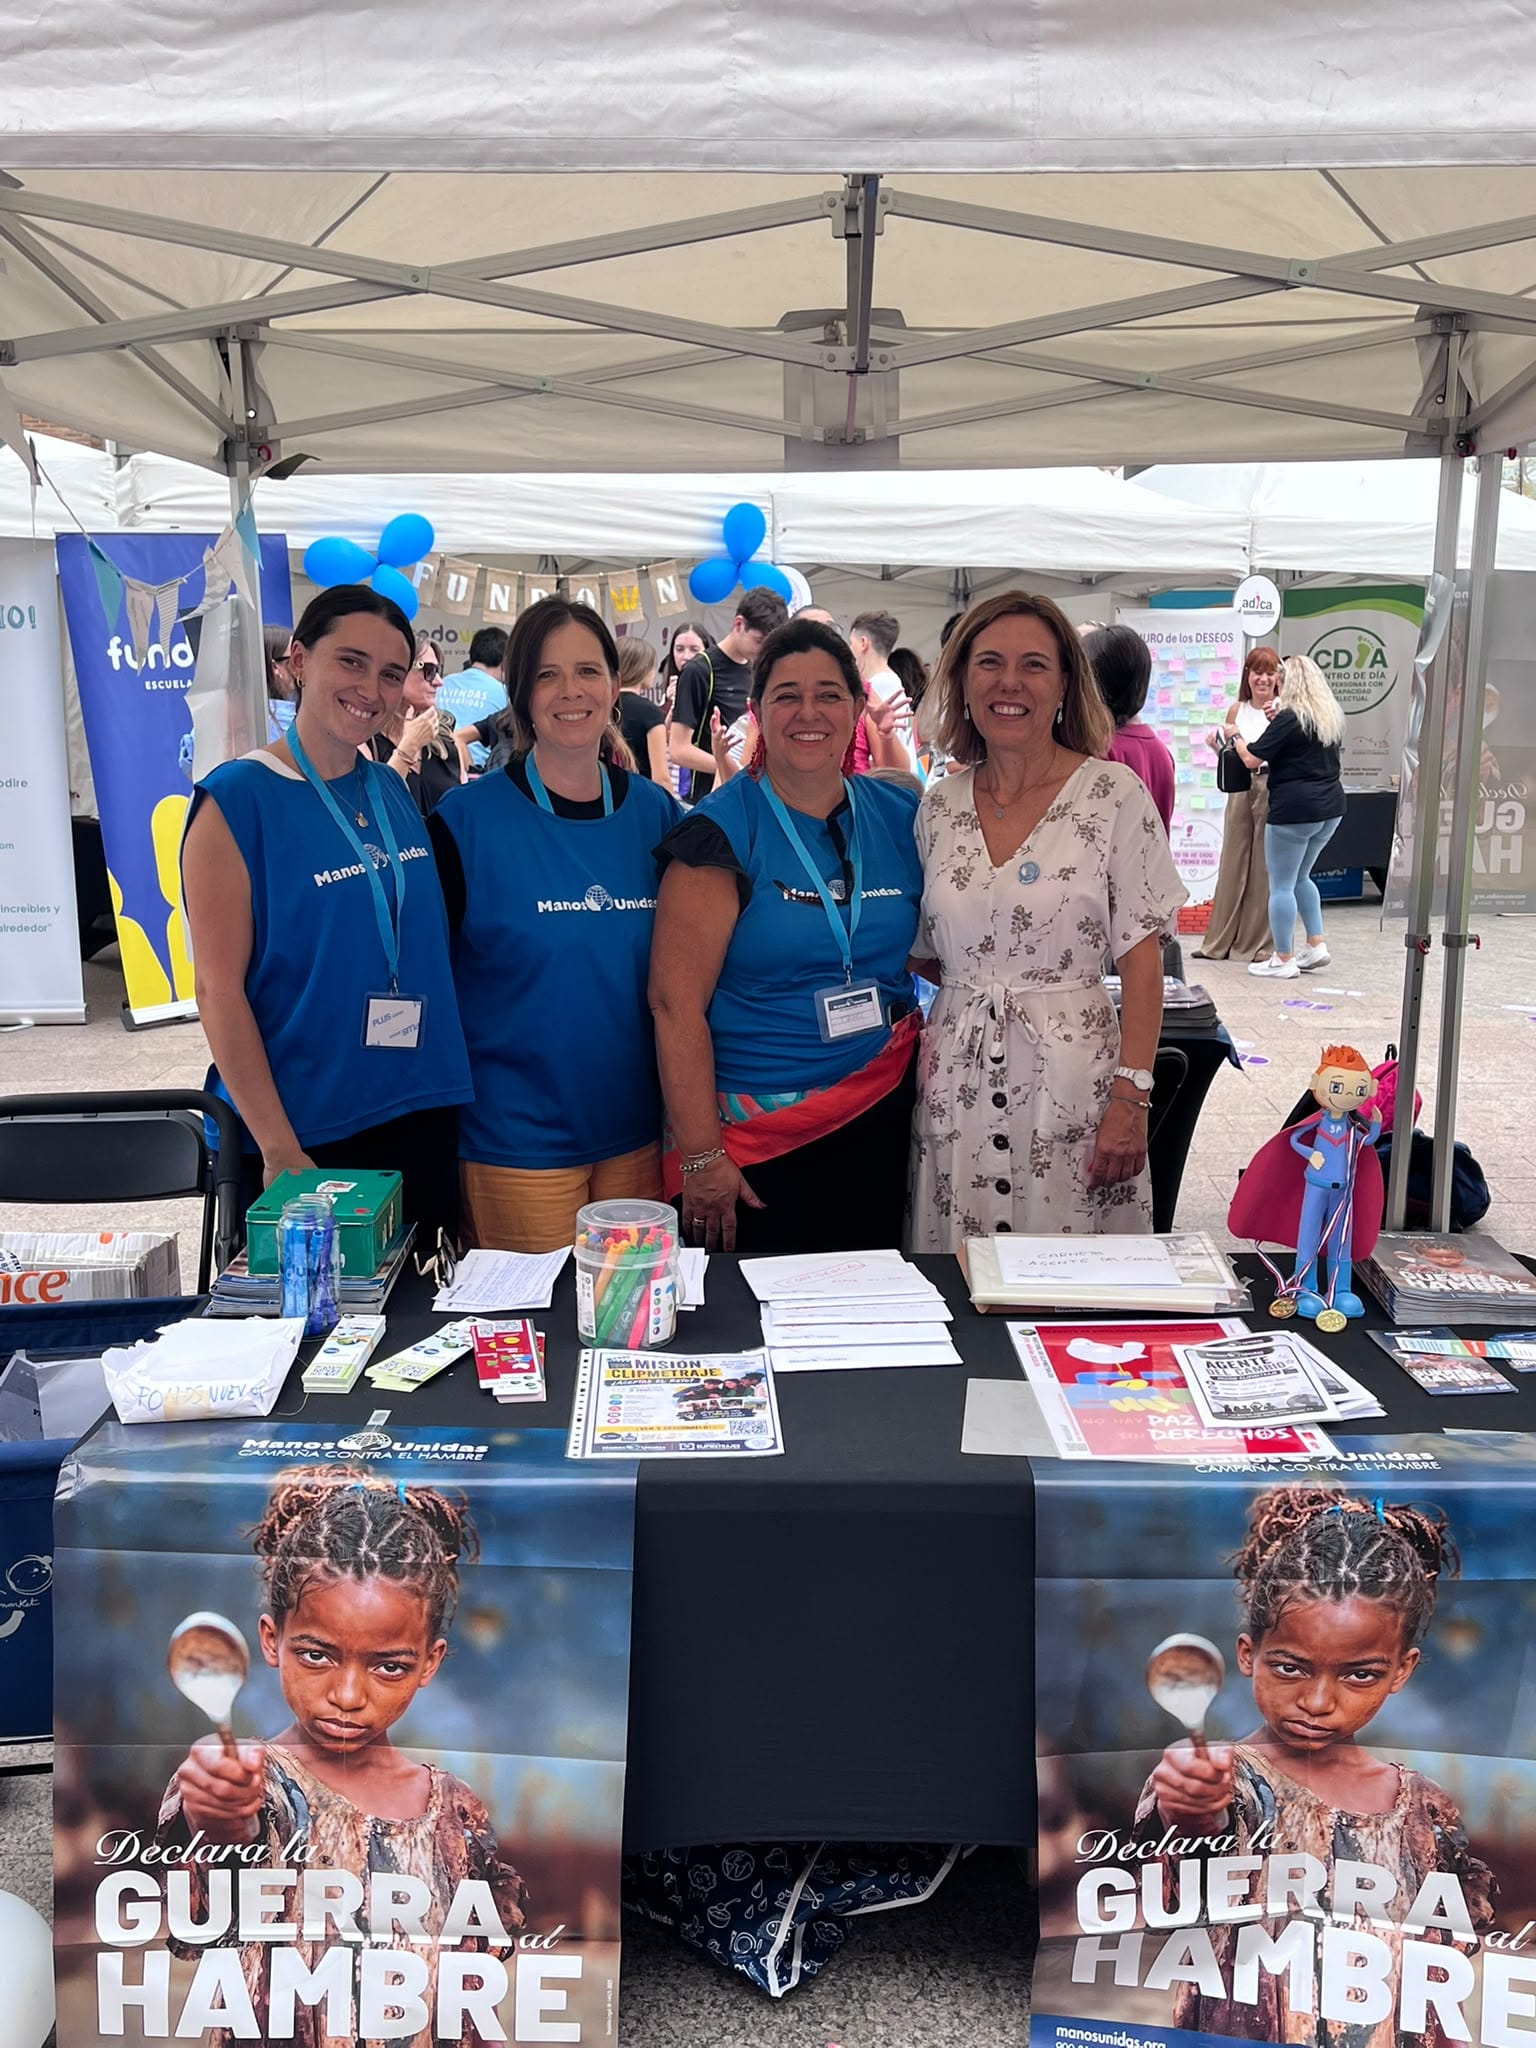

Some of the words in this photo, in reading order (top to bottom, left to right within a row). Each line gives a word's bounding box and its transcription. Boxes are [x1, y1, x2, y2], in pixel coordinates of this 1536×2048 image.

[1165, 633, 1177, 644] de
[1179, 633, 1194, 644] los
[1195, 632, 1234, 644] DESEOS
[1353, 672, 1366, 680] DE
[1369, 670, 1386, 679] DÍA
[313, 863, 367, 888] Manos
[54, 904, 61, 916] y
[537, 900, 588, 913] Manos
[635, 1359, 701, 1370] MISIÓN
[1205, 1368, 1232, 1376] DEL
[1235, 1361, 1286, 1375] CAMBIO
[1206, 1356, 1272, 1369] AGENTE
[611, 1368, 718, 1379] CLIPMETRAJE
[1082, 1417, 1105, 1425] NO
[1147, 1414, 1198, 1427] PAZ
[1147, 1427, 1294, 1441] DERECHOS
[241, 1438, 335, 1450] Manos
[391, 1442, 489, 1454] Unidas
[238, 1448, 321, 1458] CAMPAÑA
[325, 1449, 393, 1459] CONTRA
[399, 1452, 415, 1460] EL
[417, 1452, 484, 1461] HAMBRE
[1195, 1463, 1279, 1473] CAMPAÑA
[1282, 1463, 1352, 1473] CONTRA
[1355, 1463, 1373, 1471] EL
[1376, 1461, 1442, 1471] HAMBRE
[94, 1828, 270, 1867] Declara
[280, 1829, 318, 1864] la
[1073, 1823, 1241, 1865] Declara
[1247, 1819, 1285, 1851] la
[1076, 1853, 1479, 1944] GUERRA
[94, 1869, 514, 1948] GUERRA
[518, 1924, 562, 1950] al
[1484, 1921, 1536, 1950] al
[1071, 1919, 1536, 2048] HAMBRE
[97, 1947, 583, 2043] HAMBRE
[1056, 2026, 1167, 2048] manosunidas.org
